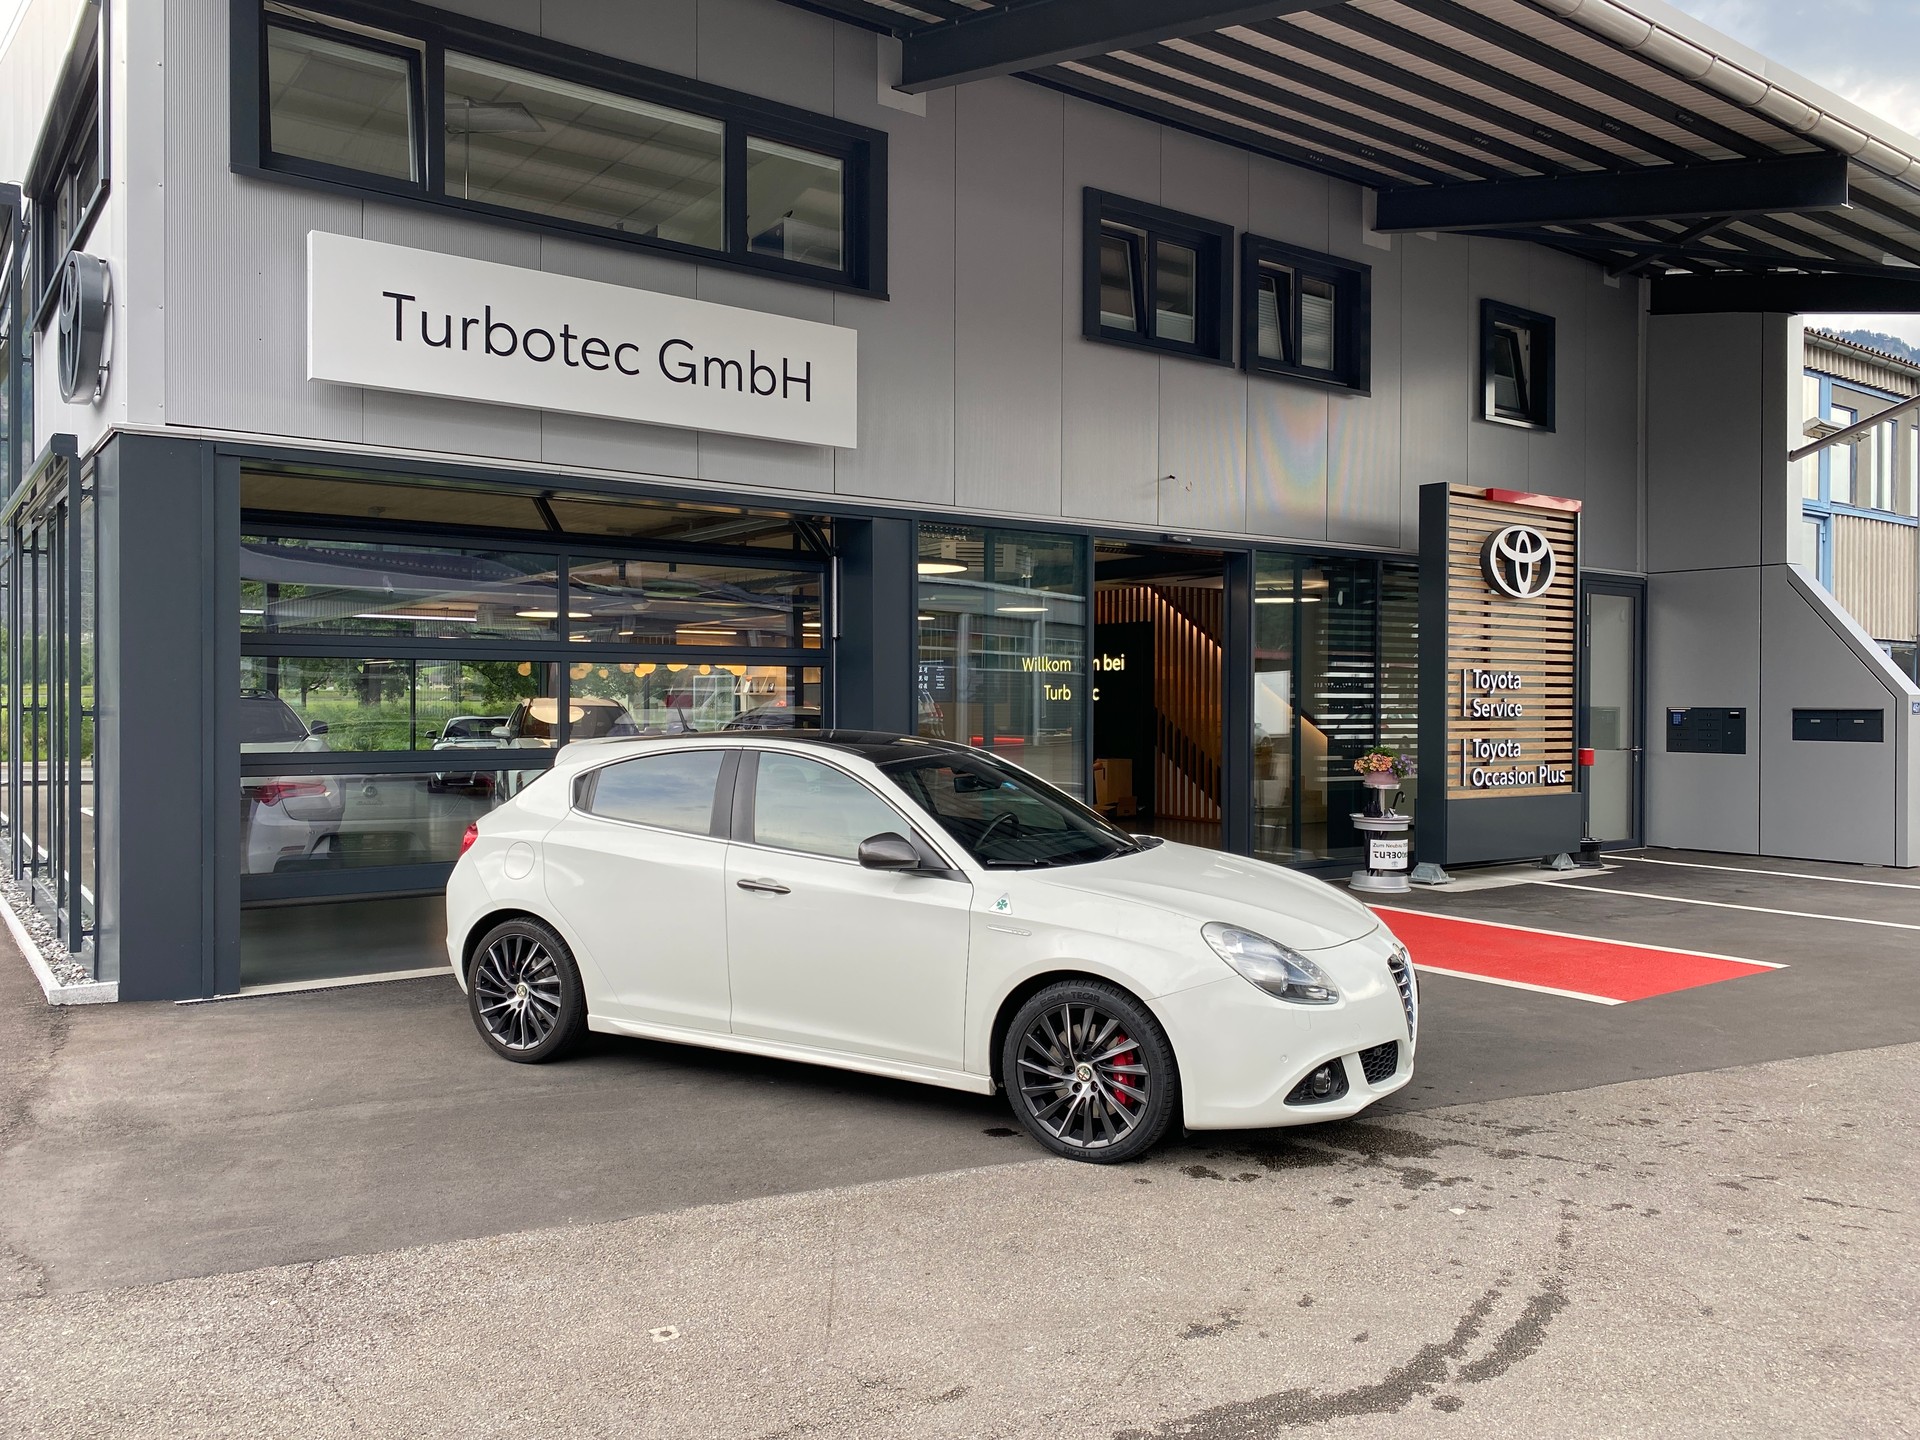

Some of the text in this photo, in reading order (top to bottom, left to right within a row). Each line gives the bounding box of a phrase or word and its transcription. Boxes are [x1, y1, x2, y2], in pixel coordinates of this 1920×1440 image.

[382, 291, 812, 402] Turbotec GmbH
[1103, 653, 1125, 671] bei
[1473, 669, 1521, 694] Toyota
[1473, 698, 1523, 717] Service
[1473, 738, 1521, 763] Toyota
[1472, 764, 1566, 787] Occasion Plus
